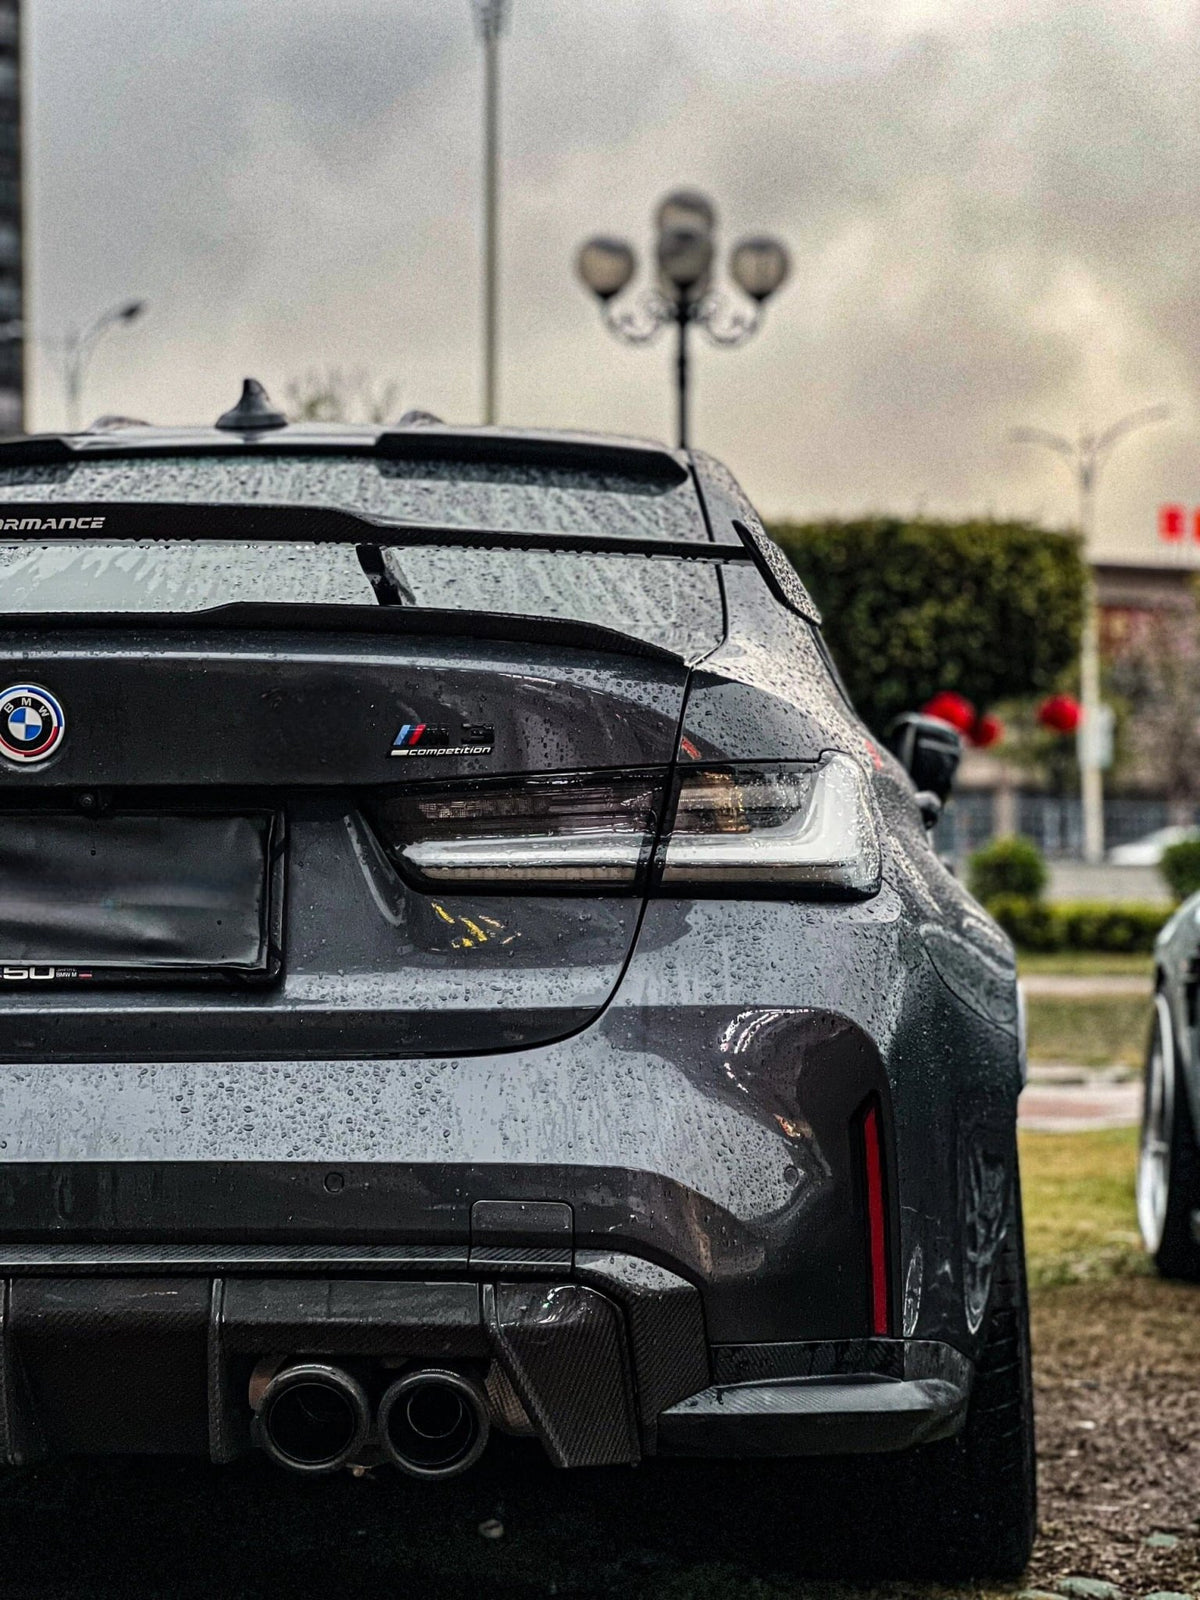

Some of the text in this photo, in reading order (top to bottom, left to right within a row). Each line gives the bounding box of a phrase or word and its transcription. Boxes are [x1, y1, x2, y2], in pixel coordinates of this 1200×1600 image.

[0, 517, 106, 530] RMANCE
[3, 697, 50, 718] BMW
[408, 746, 491, 757] competition
